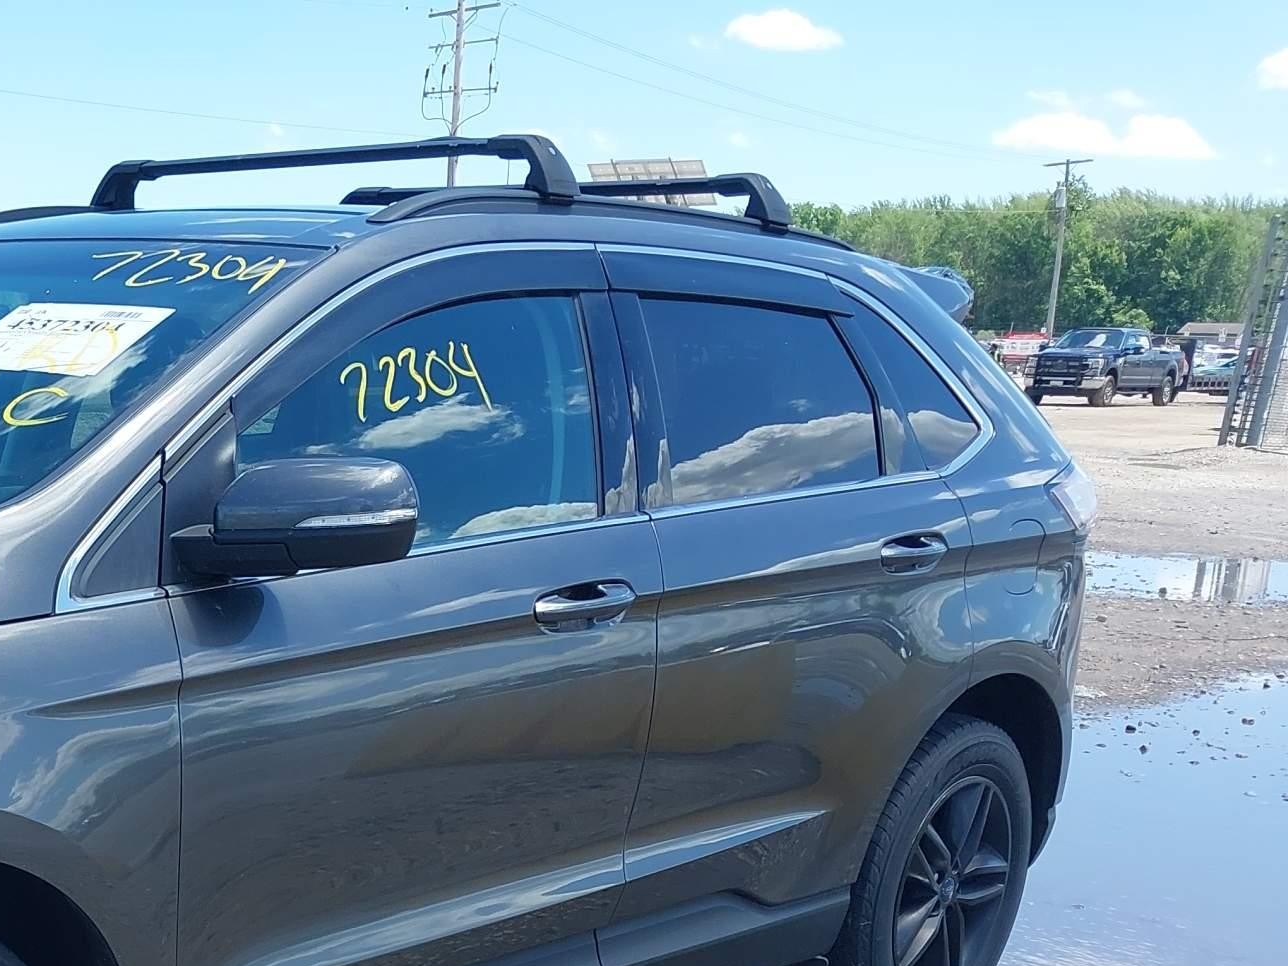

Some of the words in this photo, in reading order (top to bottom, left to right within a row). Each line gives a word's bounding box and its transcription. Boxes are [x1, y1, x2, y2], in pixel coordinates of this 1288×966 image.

[91, 249, 287, 295] 72304
[7, 317, 126, 333] 45372304
[339, 340, 494, 424] 72304
[2, 386, 69, 428] C
